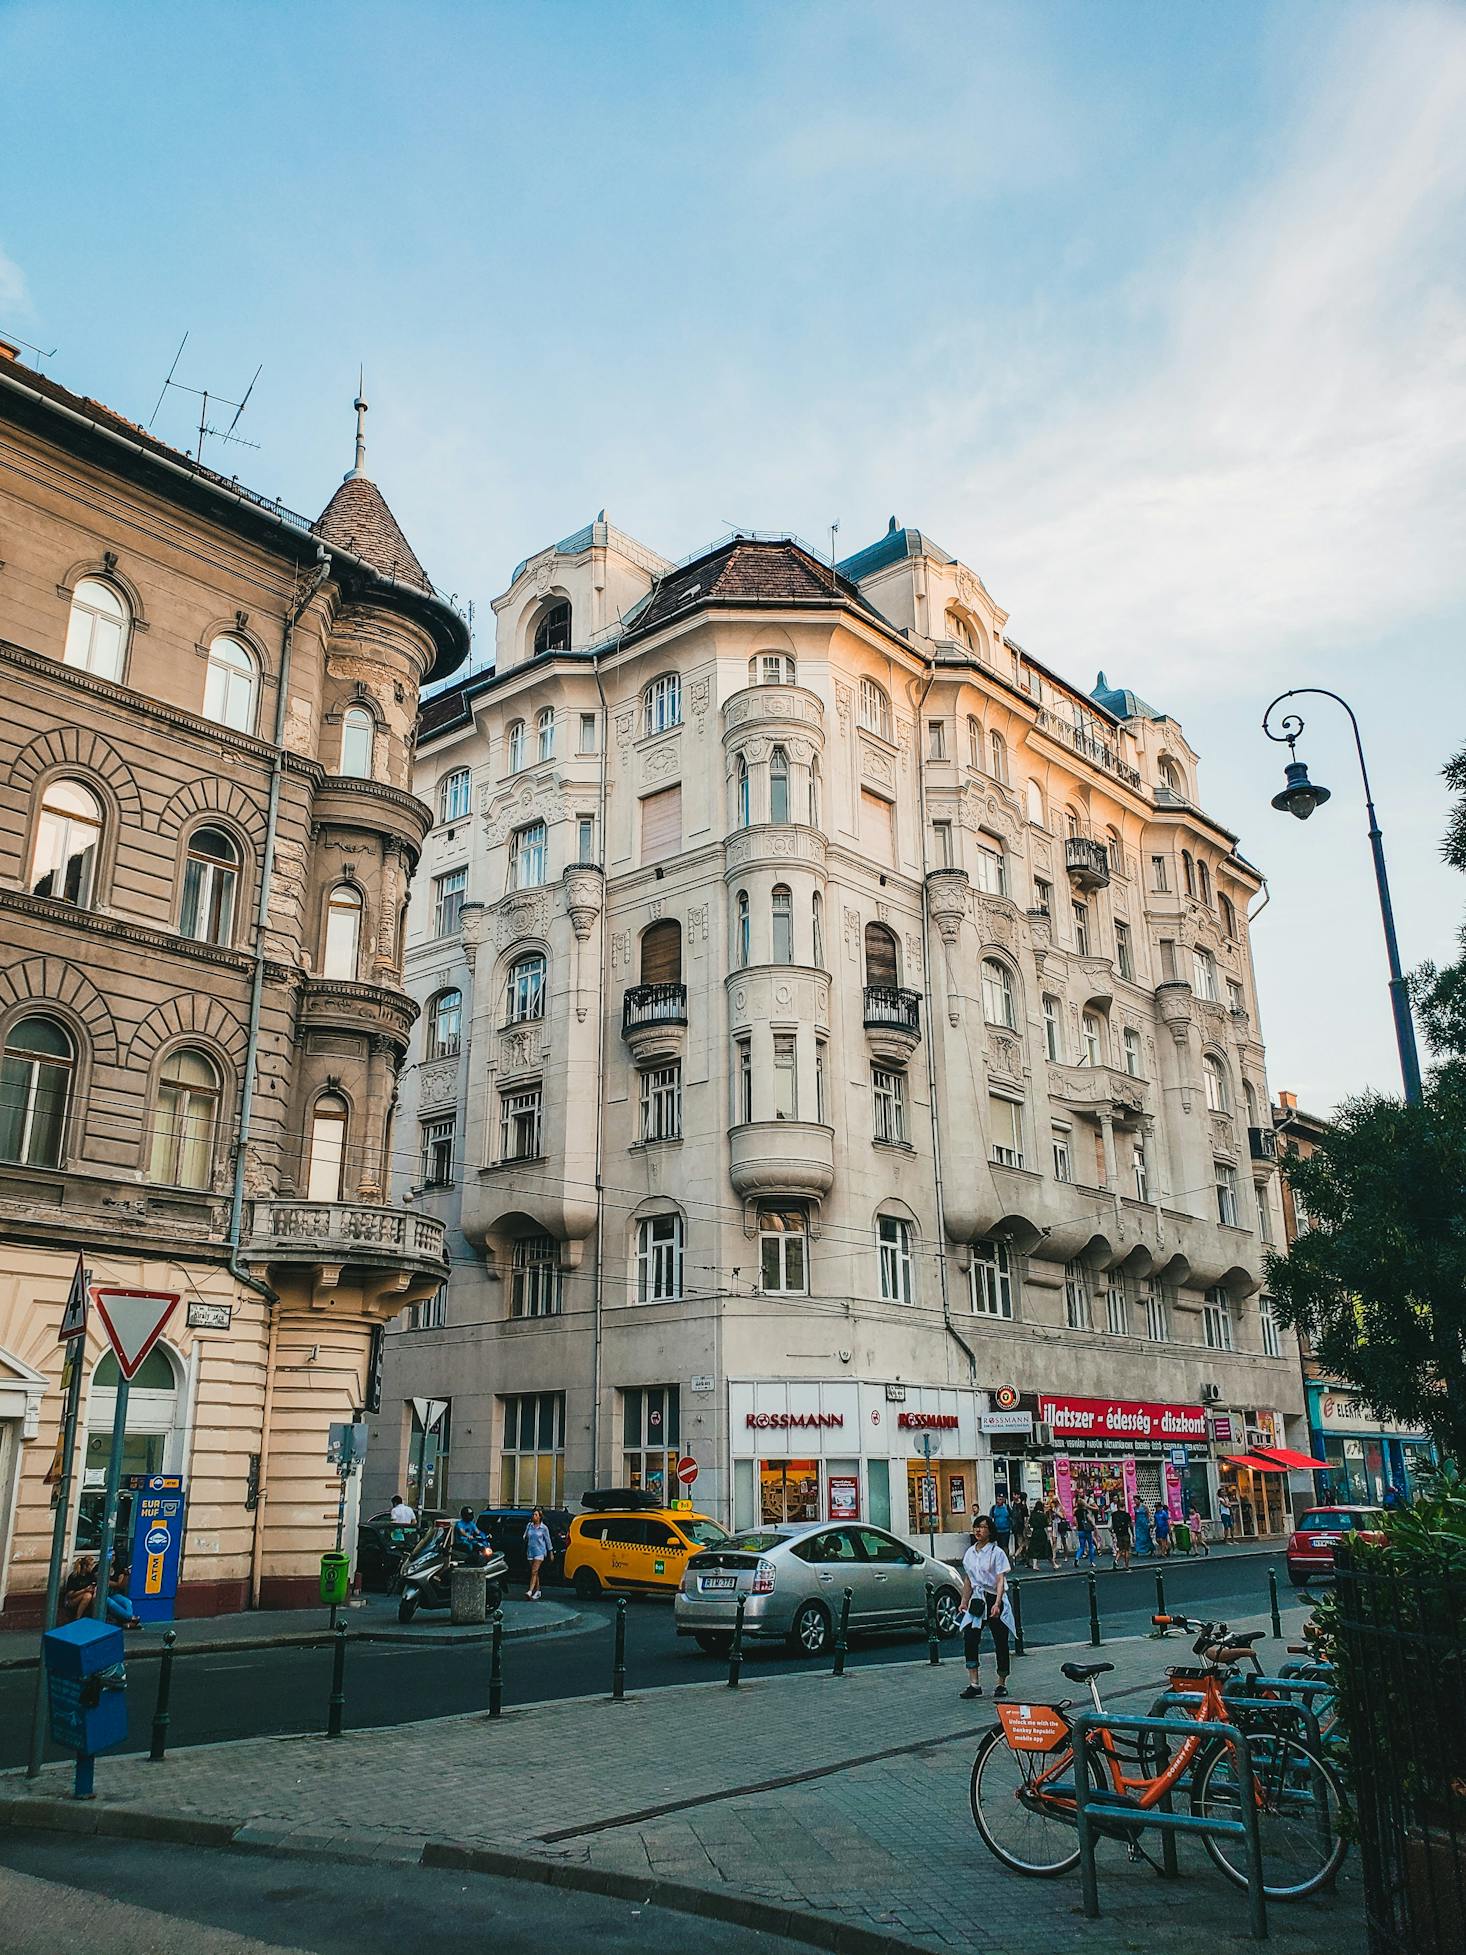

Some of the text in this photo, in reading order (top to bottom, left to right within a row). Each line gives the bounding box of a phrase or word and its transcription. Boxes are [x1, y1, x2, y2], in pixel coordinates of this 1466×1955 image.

[746, 1413, 844, 1429] ROSSMANN
[898, 1412, 959, 1429] ROSSMANN
[983, 1416, 1029, 1424] ROSSMANN
[1043, 1403, 1094, 1429] illatszer
[1106, 1406, 1150, 1434] édesség
[1161, 1411, 1206, 1434] diszkont
[142, 1500, 160, 1508] EUR
[141, 1508, 159, 1517] HUF
[151, 1558, 159, 1581] ATM
[1032, 1727, 1056, 1735] Republic
